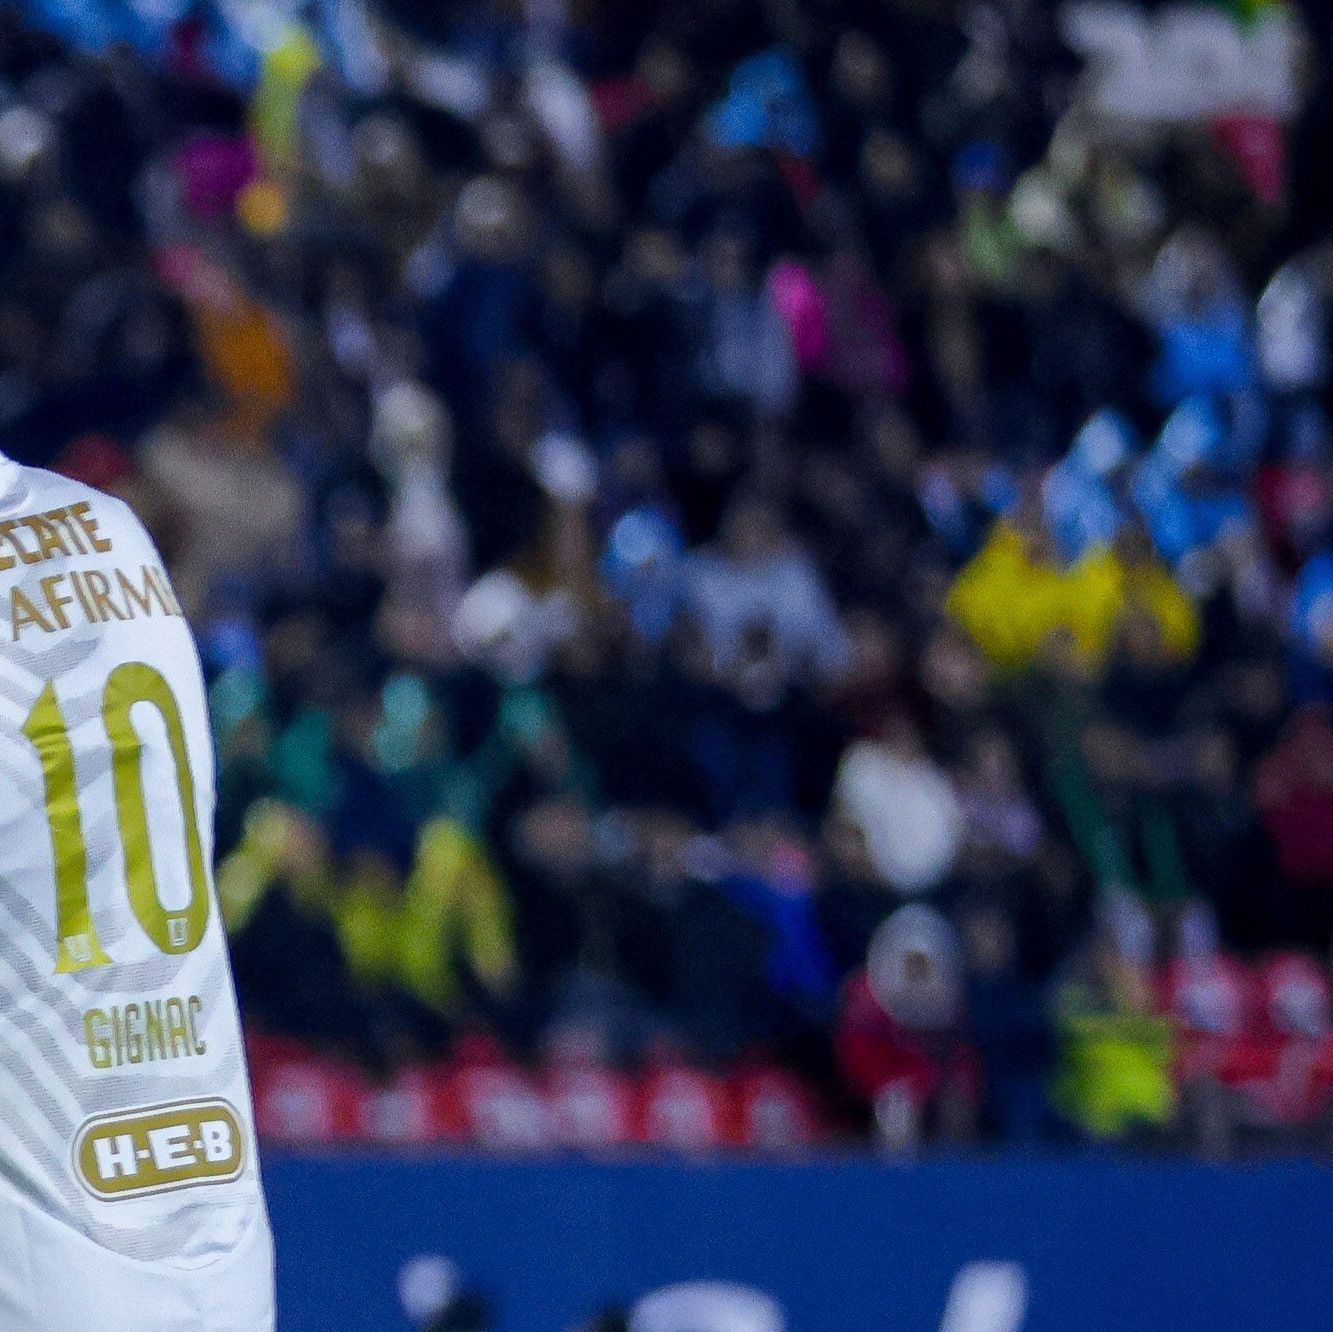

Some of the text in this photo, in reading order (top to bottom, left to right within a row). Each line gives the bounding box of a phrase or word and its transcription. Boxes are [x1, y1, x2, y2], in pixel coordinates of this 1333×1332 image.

[21, 661, 209, 973] 10
[82, 995, 206, 1069] GIGNAC
[92, 1119, 235, 1180] H-E-B
